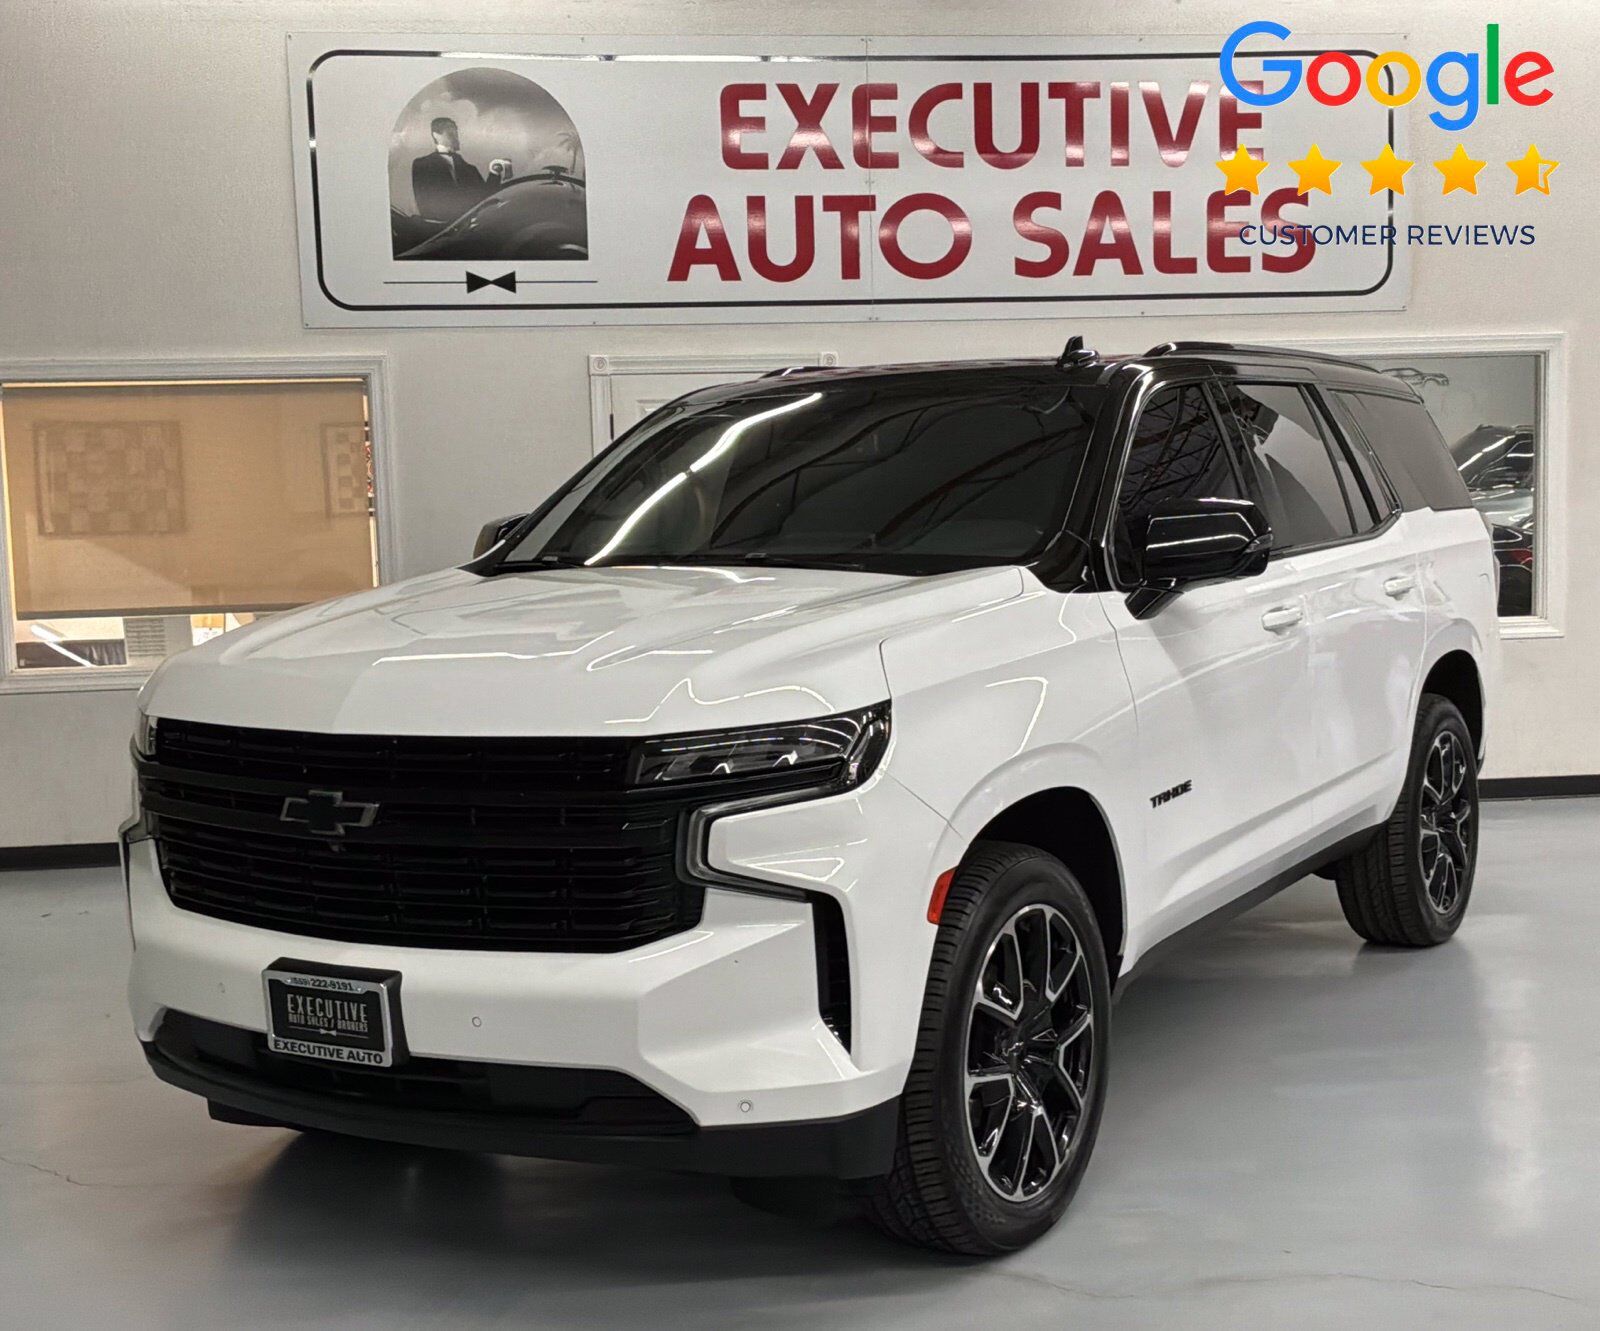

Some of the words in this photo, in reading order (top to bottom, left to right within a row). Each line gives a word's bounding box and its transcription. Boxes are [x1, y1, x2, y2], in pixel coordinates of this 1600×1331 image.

[719, 80, 1264, 170] EXECUTIVE
[667, 192, 973, 283] AUTO
[1014, 187, 1316, 279] SALES
[1150, 779, 1192, 808] TAHOE
[287, 993, 368, 1023] EXECUTIVE
[307, 1016, 329, 1028] SALES
[274, 1040, 344, 1059] EXECUTIVE
[347, 1051, 383, 1064] AUTO
